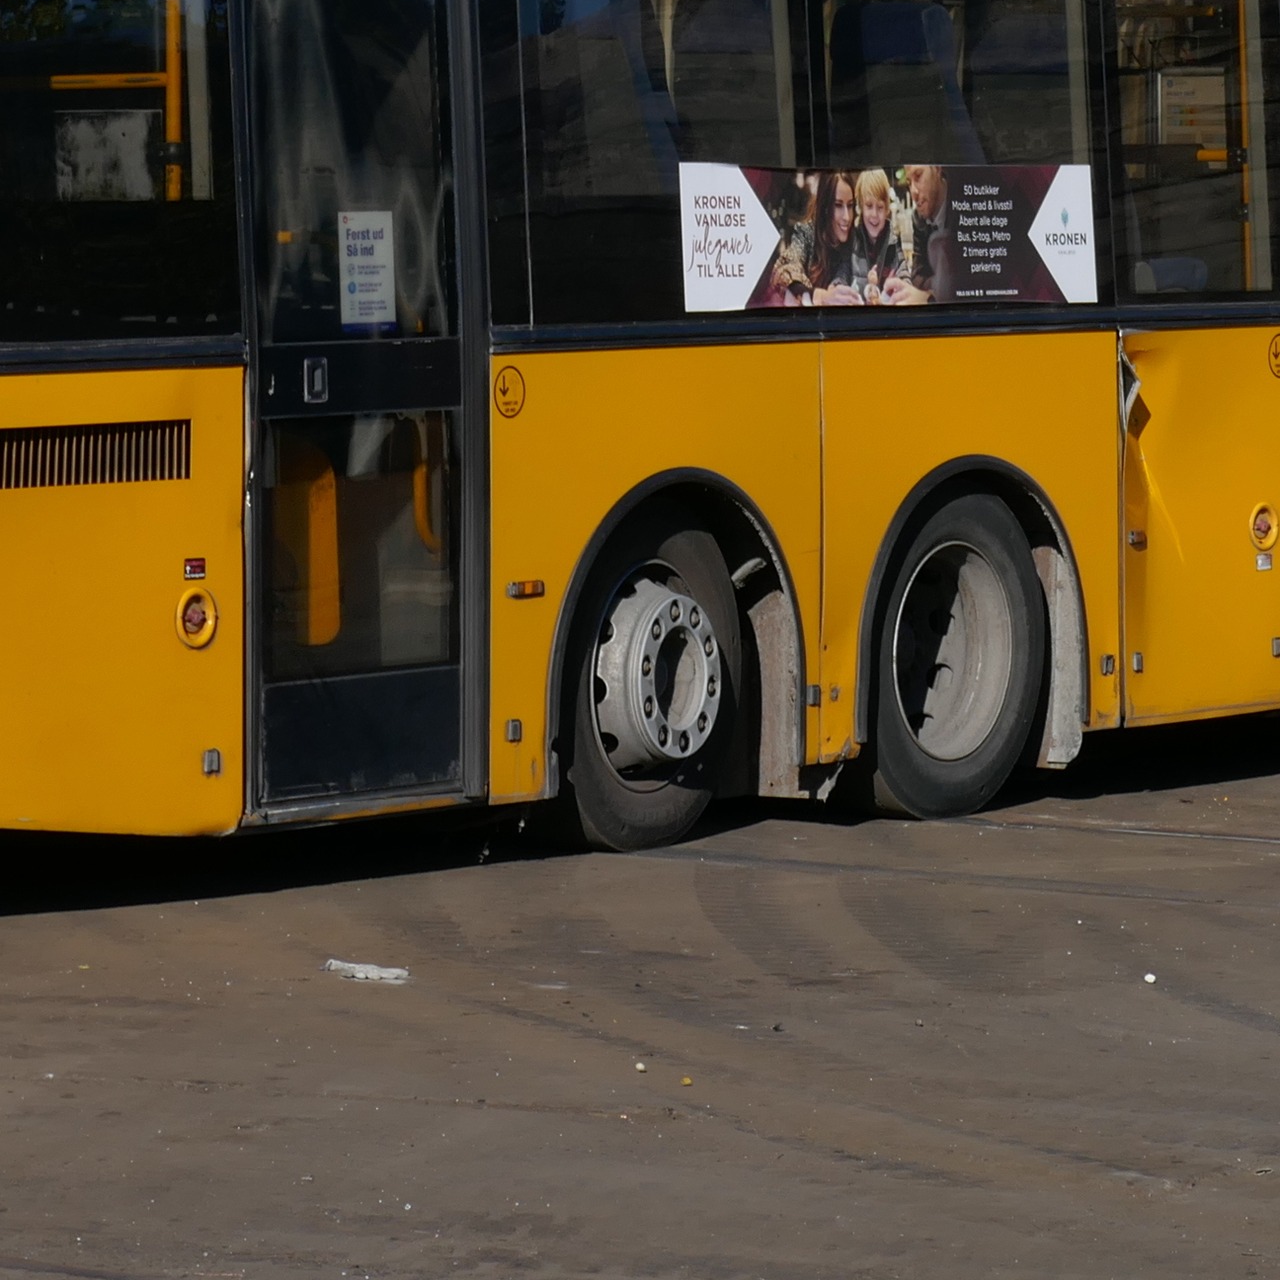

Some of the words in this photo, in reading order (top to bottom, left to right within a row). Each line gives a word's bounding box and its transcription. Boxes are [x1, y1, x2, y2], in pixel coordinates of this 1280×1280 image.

[963, 185, 972, 195] 50
[974, 185, 999, 195] butikker
[694, 196, 741, 209] KRONEN
[952, 201, 971, 211] Mode,
[972, 200, 987, 210] mad
[695, 214, 746, 227] VANLØSE
[959, 214, 978, 226] Åbent
[979, 216, 991, 226] alle
[992, 216, 1008, 227] dage
[372, 228, 384, 240] ud
[992, 231, 1011, 241] Metro
[1045, 233, 1087, 245] KRONEN
[360, 244, 374, 256] ind
[686, 223, 752, 272] julegaver
[963, 247, 967, 257] 2
[968, 247, 989, 257] timers
[989, 247, 1008, 258] gratis
[697, 264, 713, 277] TIL
[717, 264, 745, 277] ALLE
[971, 262, 1002, 274] parkering
